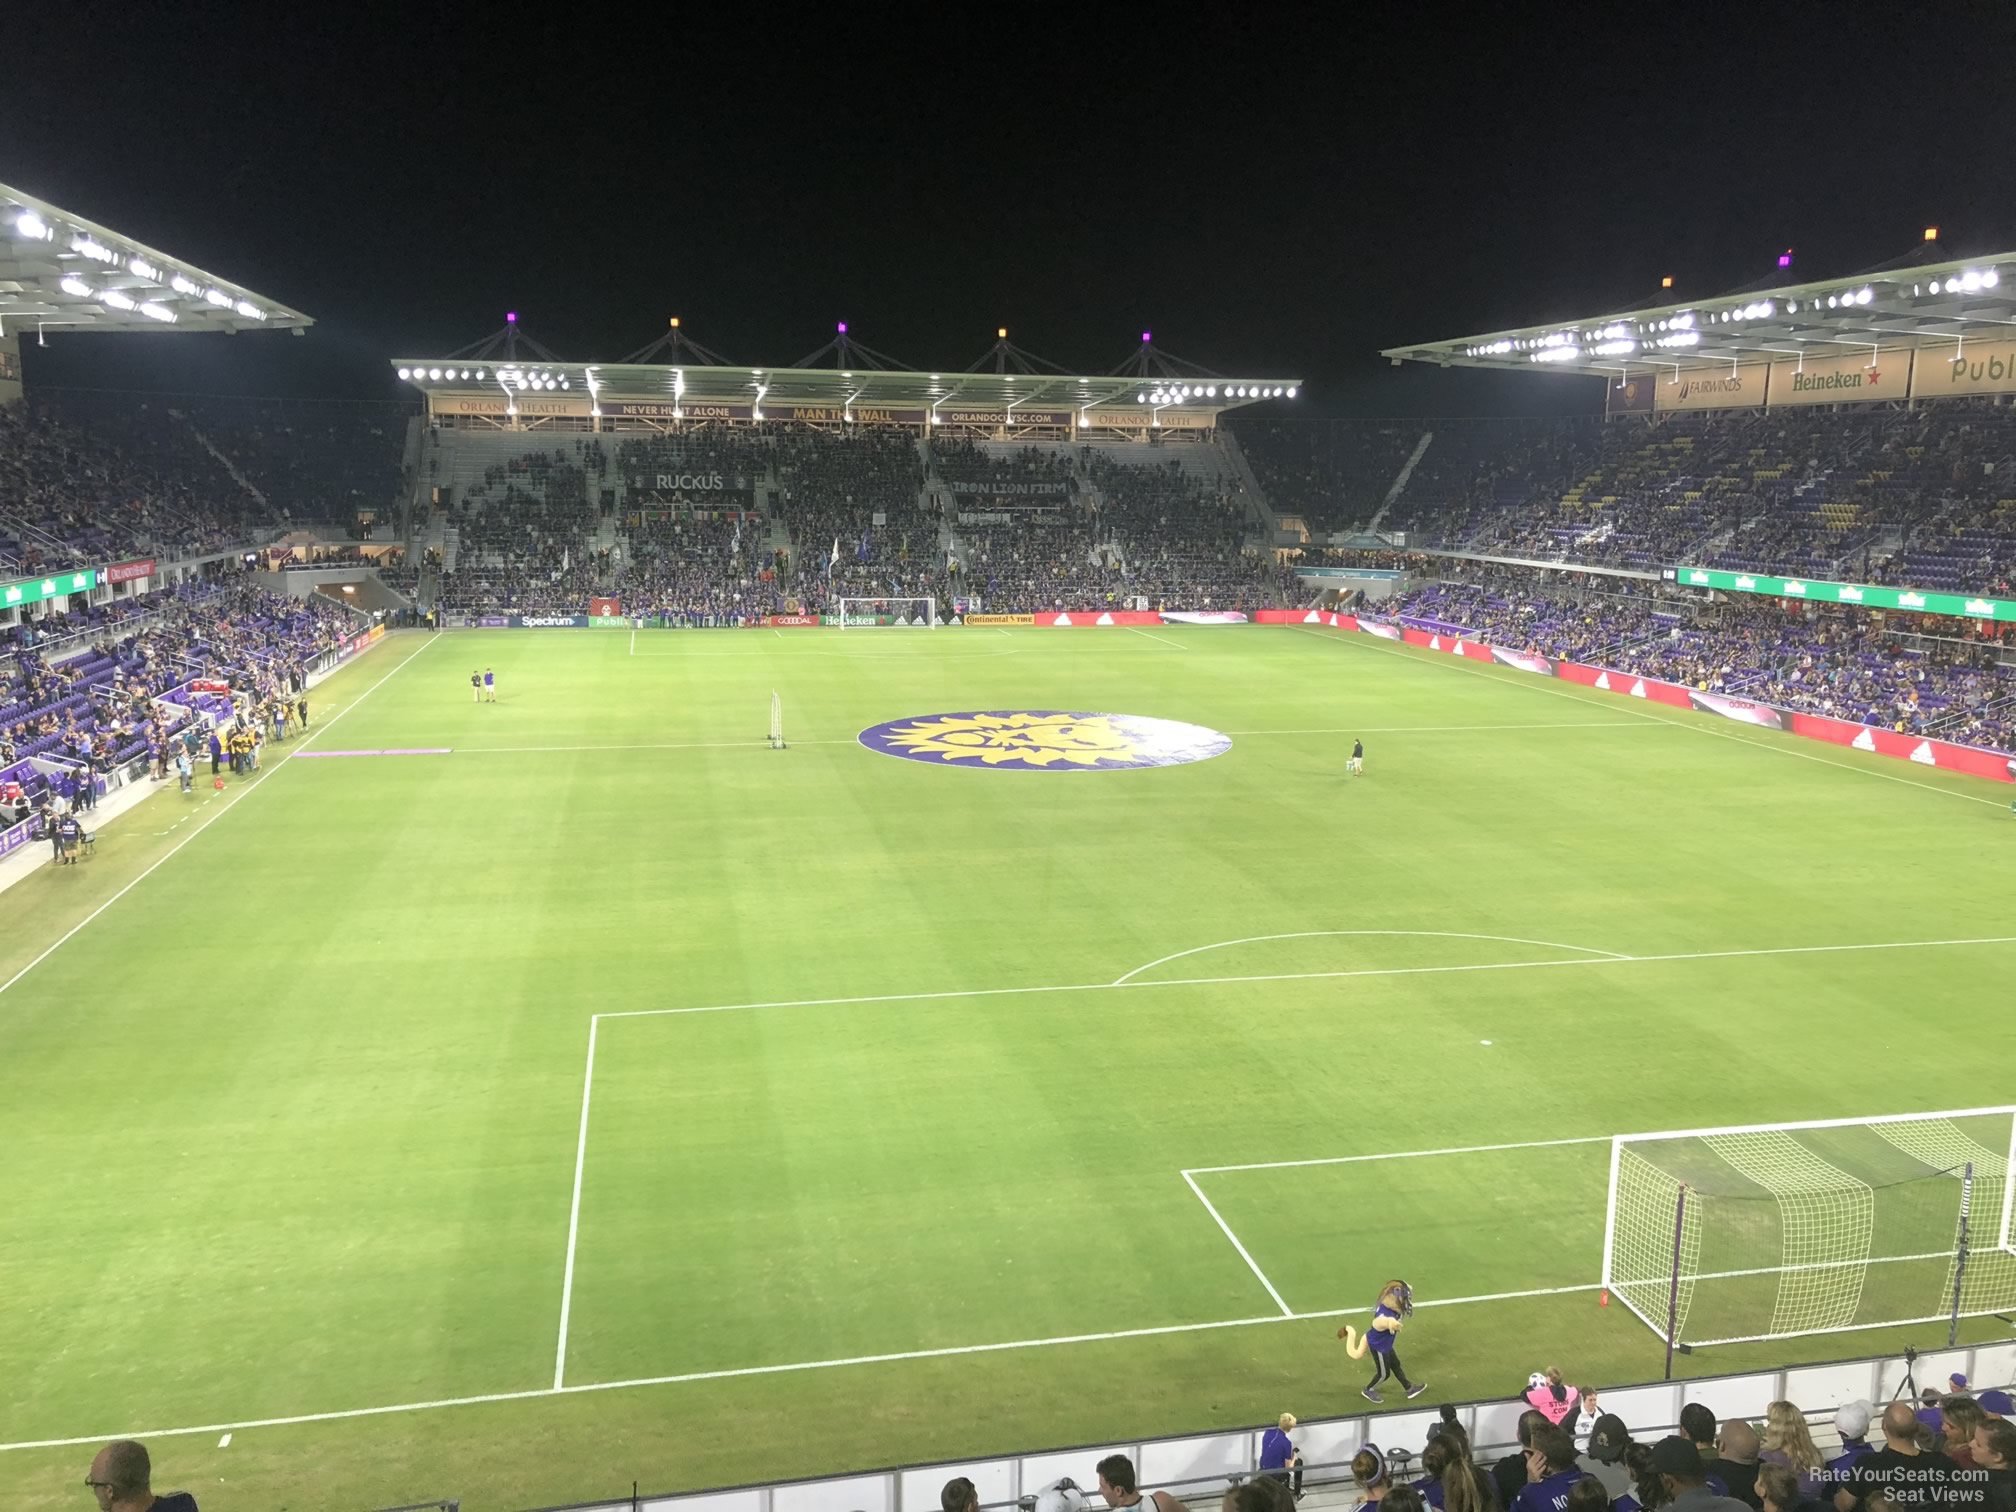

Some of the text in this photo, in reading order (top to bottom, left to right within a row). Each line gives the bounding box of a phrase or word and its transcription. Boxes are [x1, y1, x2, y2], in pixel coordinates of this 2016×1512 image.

[1690, 378, 1743, 394] FAIRWINDS
[1793, 371, 1862, 391] Heineken
[459, 401, 521, 413] ORLAN
[623, 406, 729, 417] NEVER HUT ALONE
[793, 408, 826, 419] MAN
[858, 410, 892, 421] WALL
[951, 413, 1052, 423] ORLANDOCIYSC.COM
[1099, 415, 1150, 426] ORLANDO
[656, 474, 723, 490] RUCKUS
[953, 481, 1066, 494] IRON LION FIRM
[521, 615, 572, 627] Spectrum
[596, 616, 623, 626] Publi
[966, 615, 1009, 625] Continental
